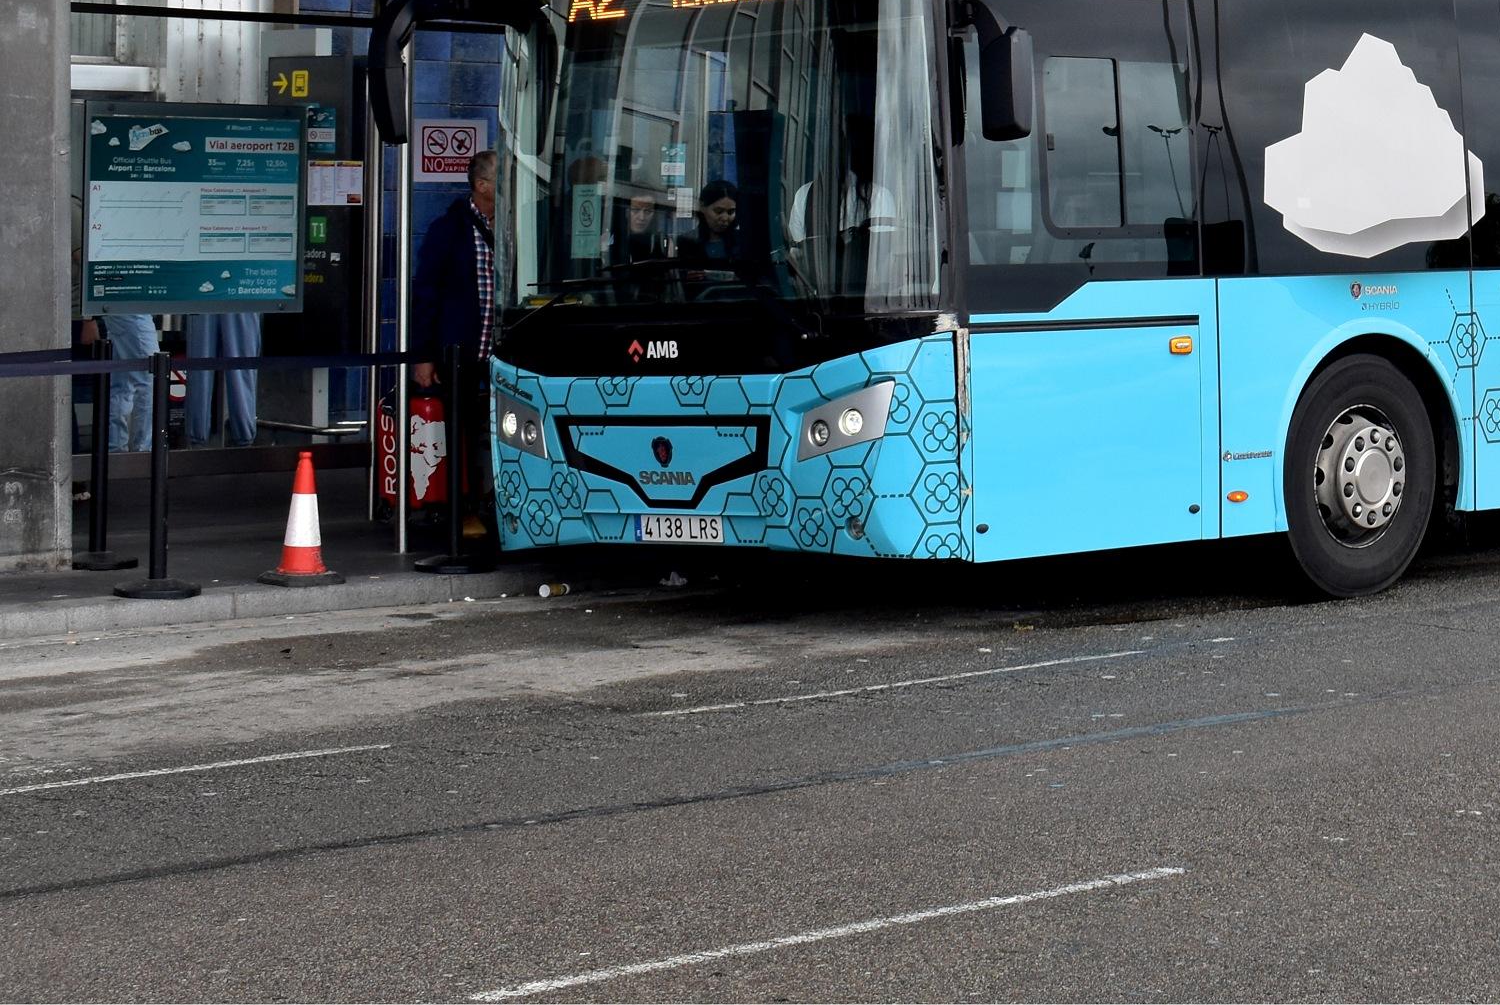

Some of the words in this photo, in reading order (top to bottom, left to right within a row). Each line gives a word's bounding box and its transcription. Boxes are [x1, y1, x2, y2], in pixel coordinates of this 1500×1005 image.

[209, 140, 228, 150] Vial
[230, 141, 273, 152] aeroport
[276, 142, 295, 151] T2B
[108, 164, 133, 172] Airport
[424, 157, 445, 172] NO
[92, 184, 101, 192] A1
[92, 223, 102, 231] A2
[311, 222, 326, 238] T1
[244, 268, 258, 276] The
[260, 268, 278, 276] best
[227, 287, 237, 295] to
[238, 286, 277, 294] Barcelona
[1364, 285, 1398, 295] SCANIA
[1368, 300, 1400, 311] HYBRID
[646, 340, 679, 359] AMB
[638, 470, 696, 486] SCANIA
[644, 516, 684, 540] 4138
[688, 517, 720, 540] LRS
